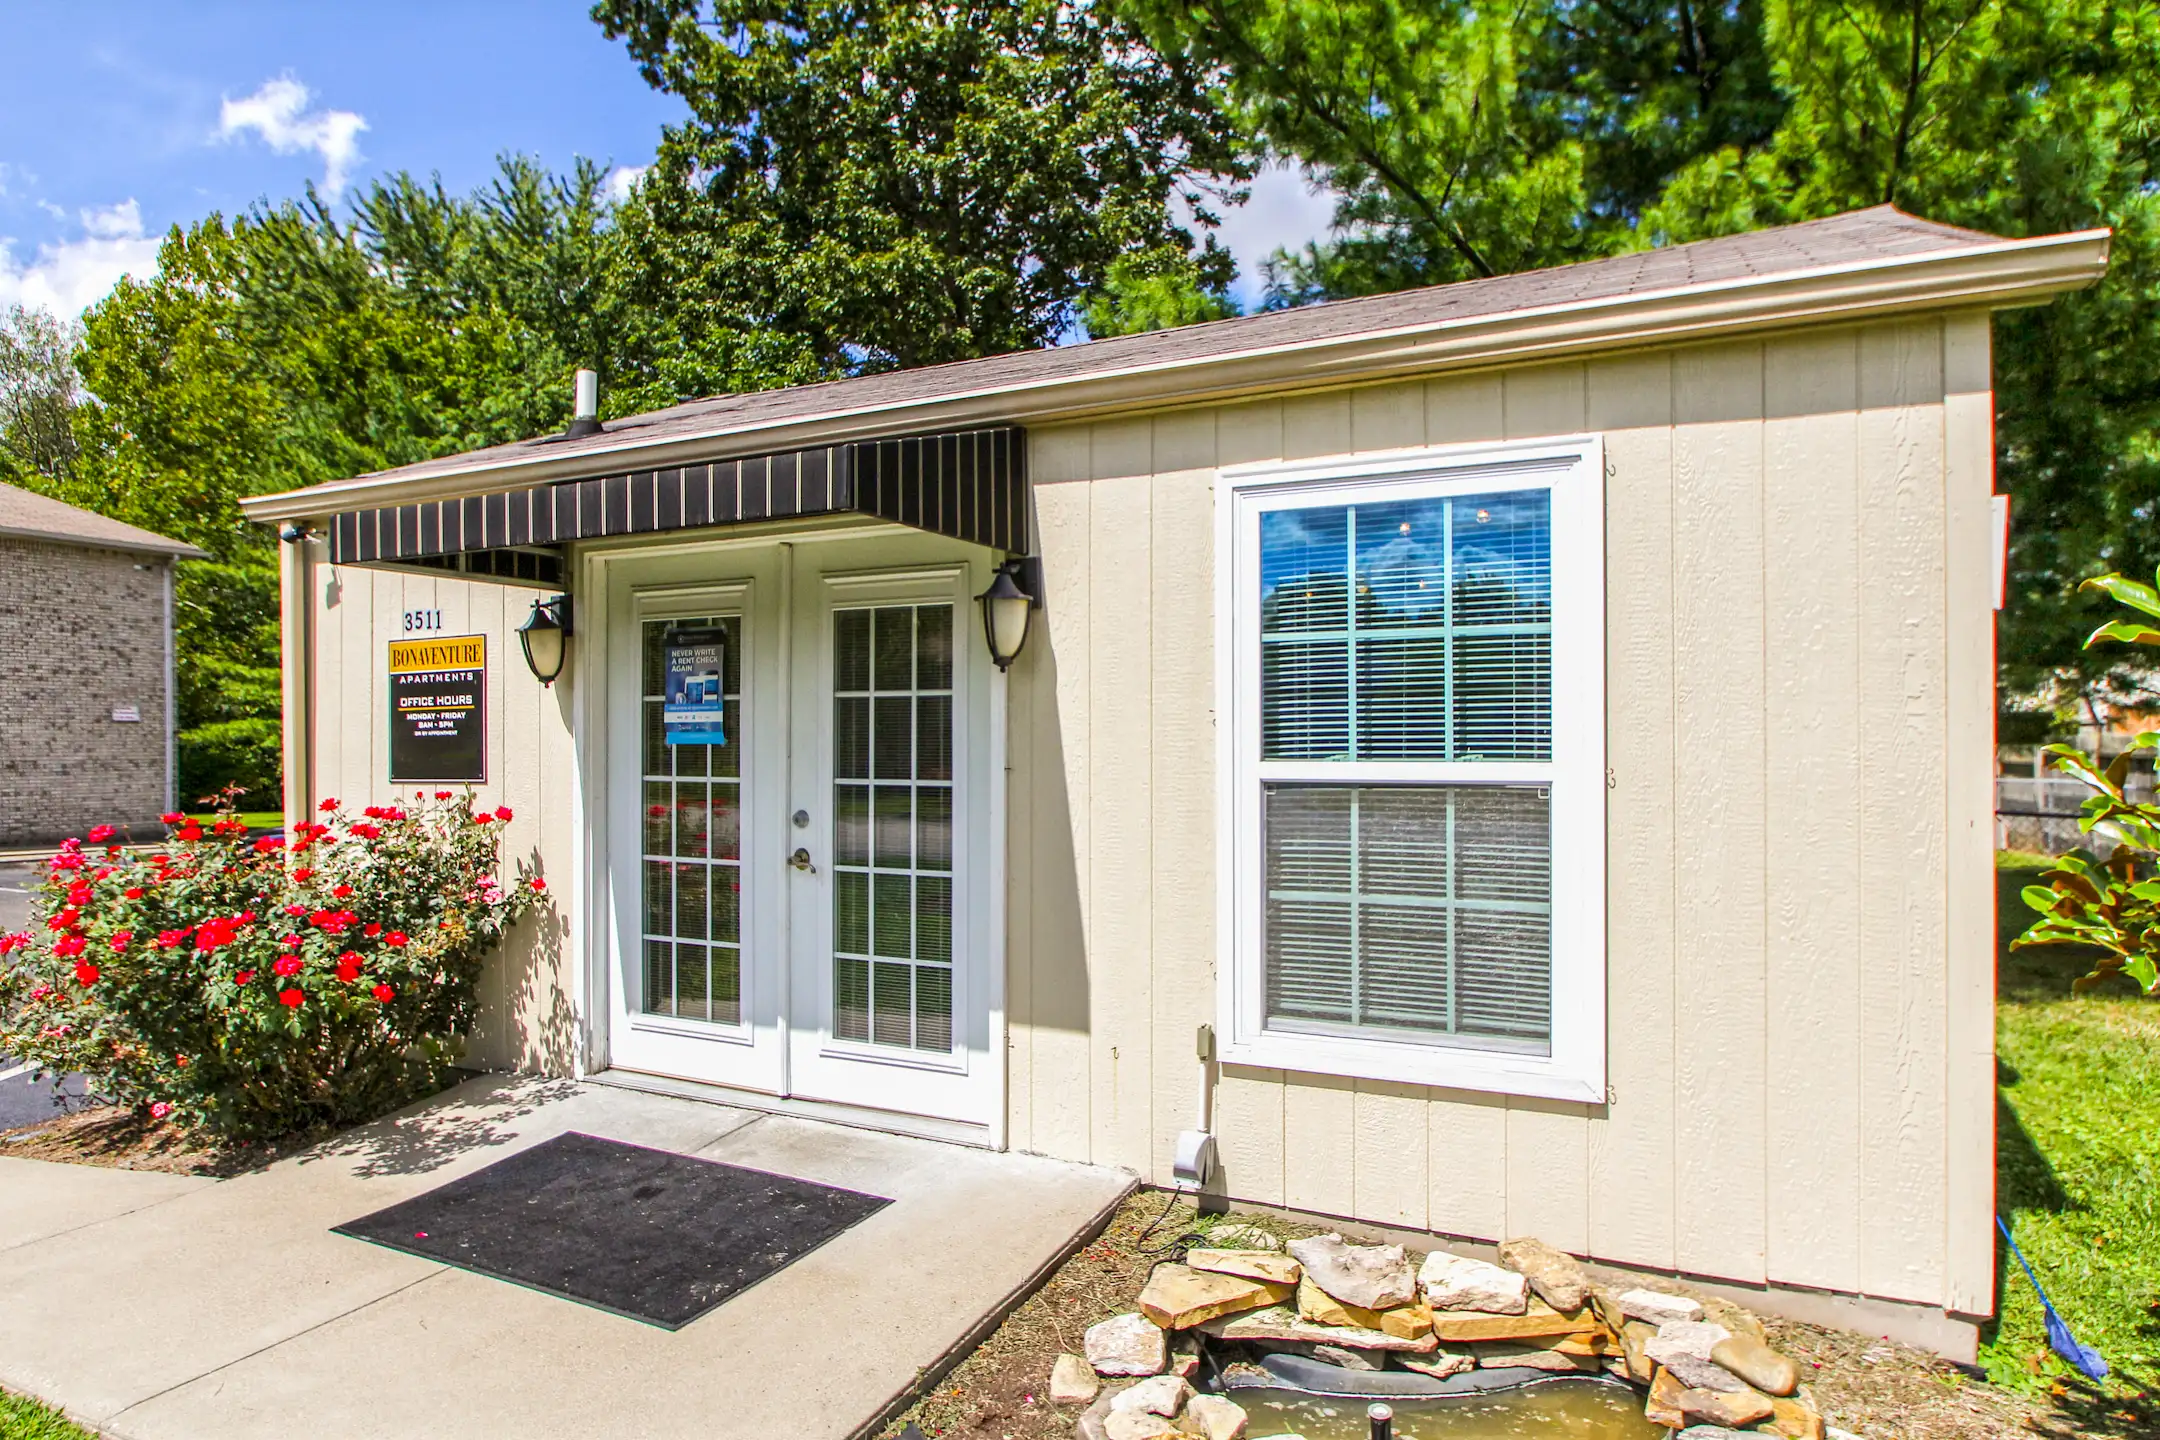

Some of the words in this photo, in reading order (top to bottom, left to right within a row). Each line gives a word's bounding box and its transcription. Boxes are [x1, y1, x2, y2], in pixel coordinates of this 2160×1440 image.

[405, 610, 441, 631] 3511
[392, 644, 480, 667] BONAVENTURE
[671, 649, 693, 658] NEVER
[694, 648, 716, 657] WRITE
[678, 657, 695, 665] RENT
[696, 656, 718, 664] CHECK
[671, 665, 693, 673] AGAIN
[399, 672, 474, 684] APARTMENTS
[400, 696, 434, 707] OFFICE
[436, 694, 473, 706] HOURS
[406, 712, 436, 721] MONDAY
[441, 711, 467, 720] FRIDAY
[418, 721, 433, 729] 8AM
[439, 720, 454, 728] 5PM
